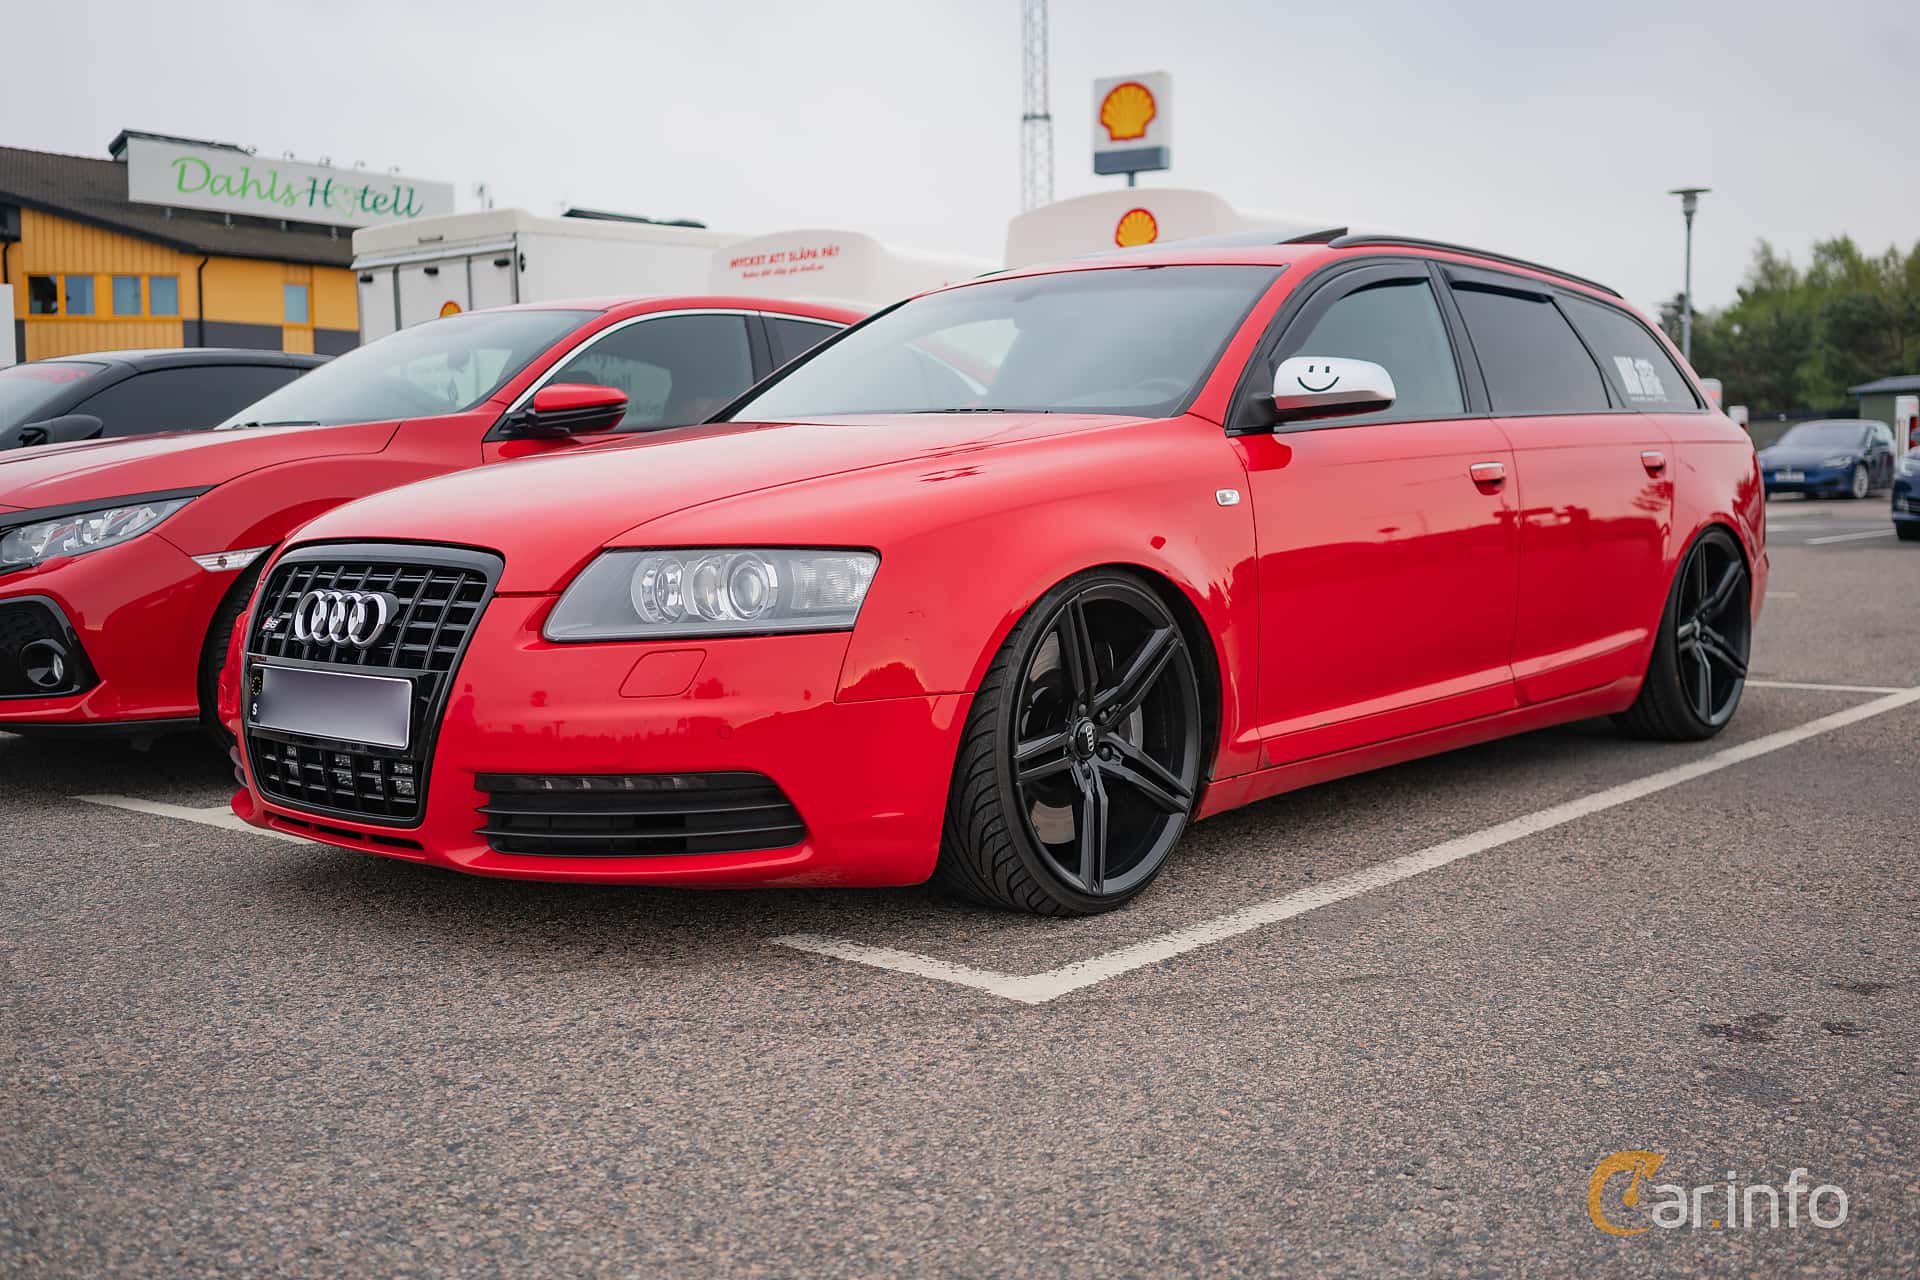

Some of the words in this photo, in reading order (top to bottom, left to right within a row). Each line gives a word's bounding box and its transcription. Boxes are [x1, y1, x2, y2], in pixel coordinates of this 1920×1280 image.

[172, 156, 302, 208] Dahls
[730, 254, 766, 268] MYCKET
[769, 252, 785, 264] ATT
[252, 703, 258, 715] S
